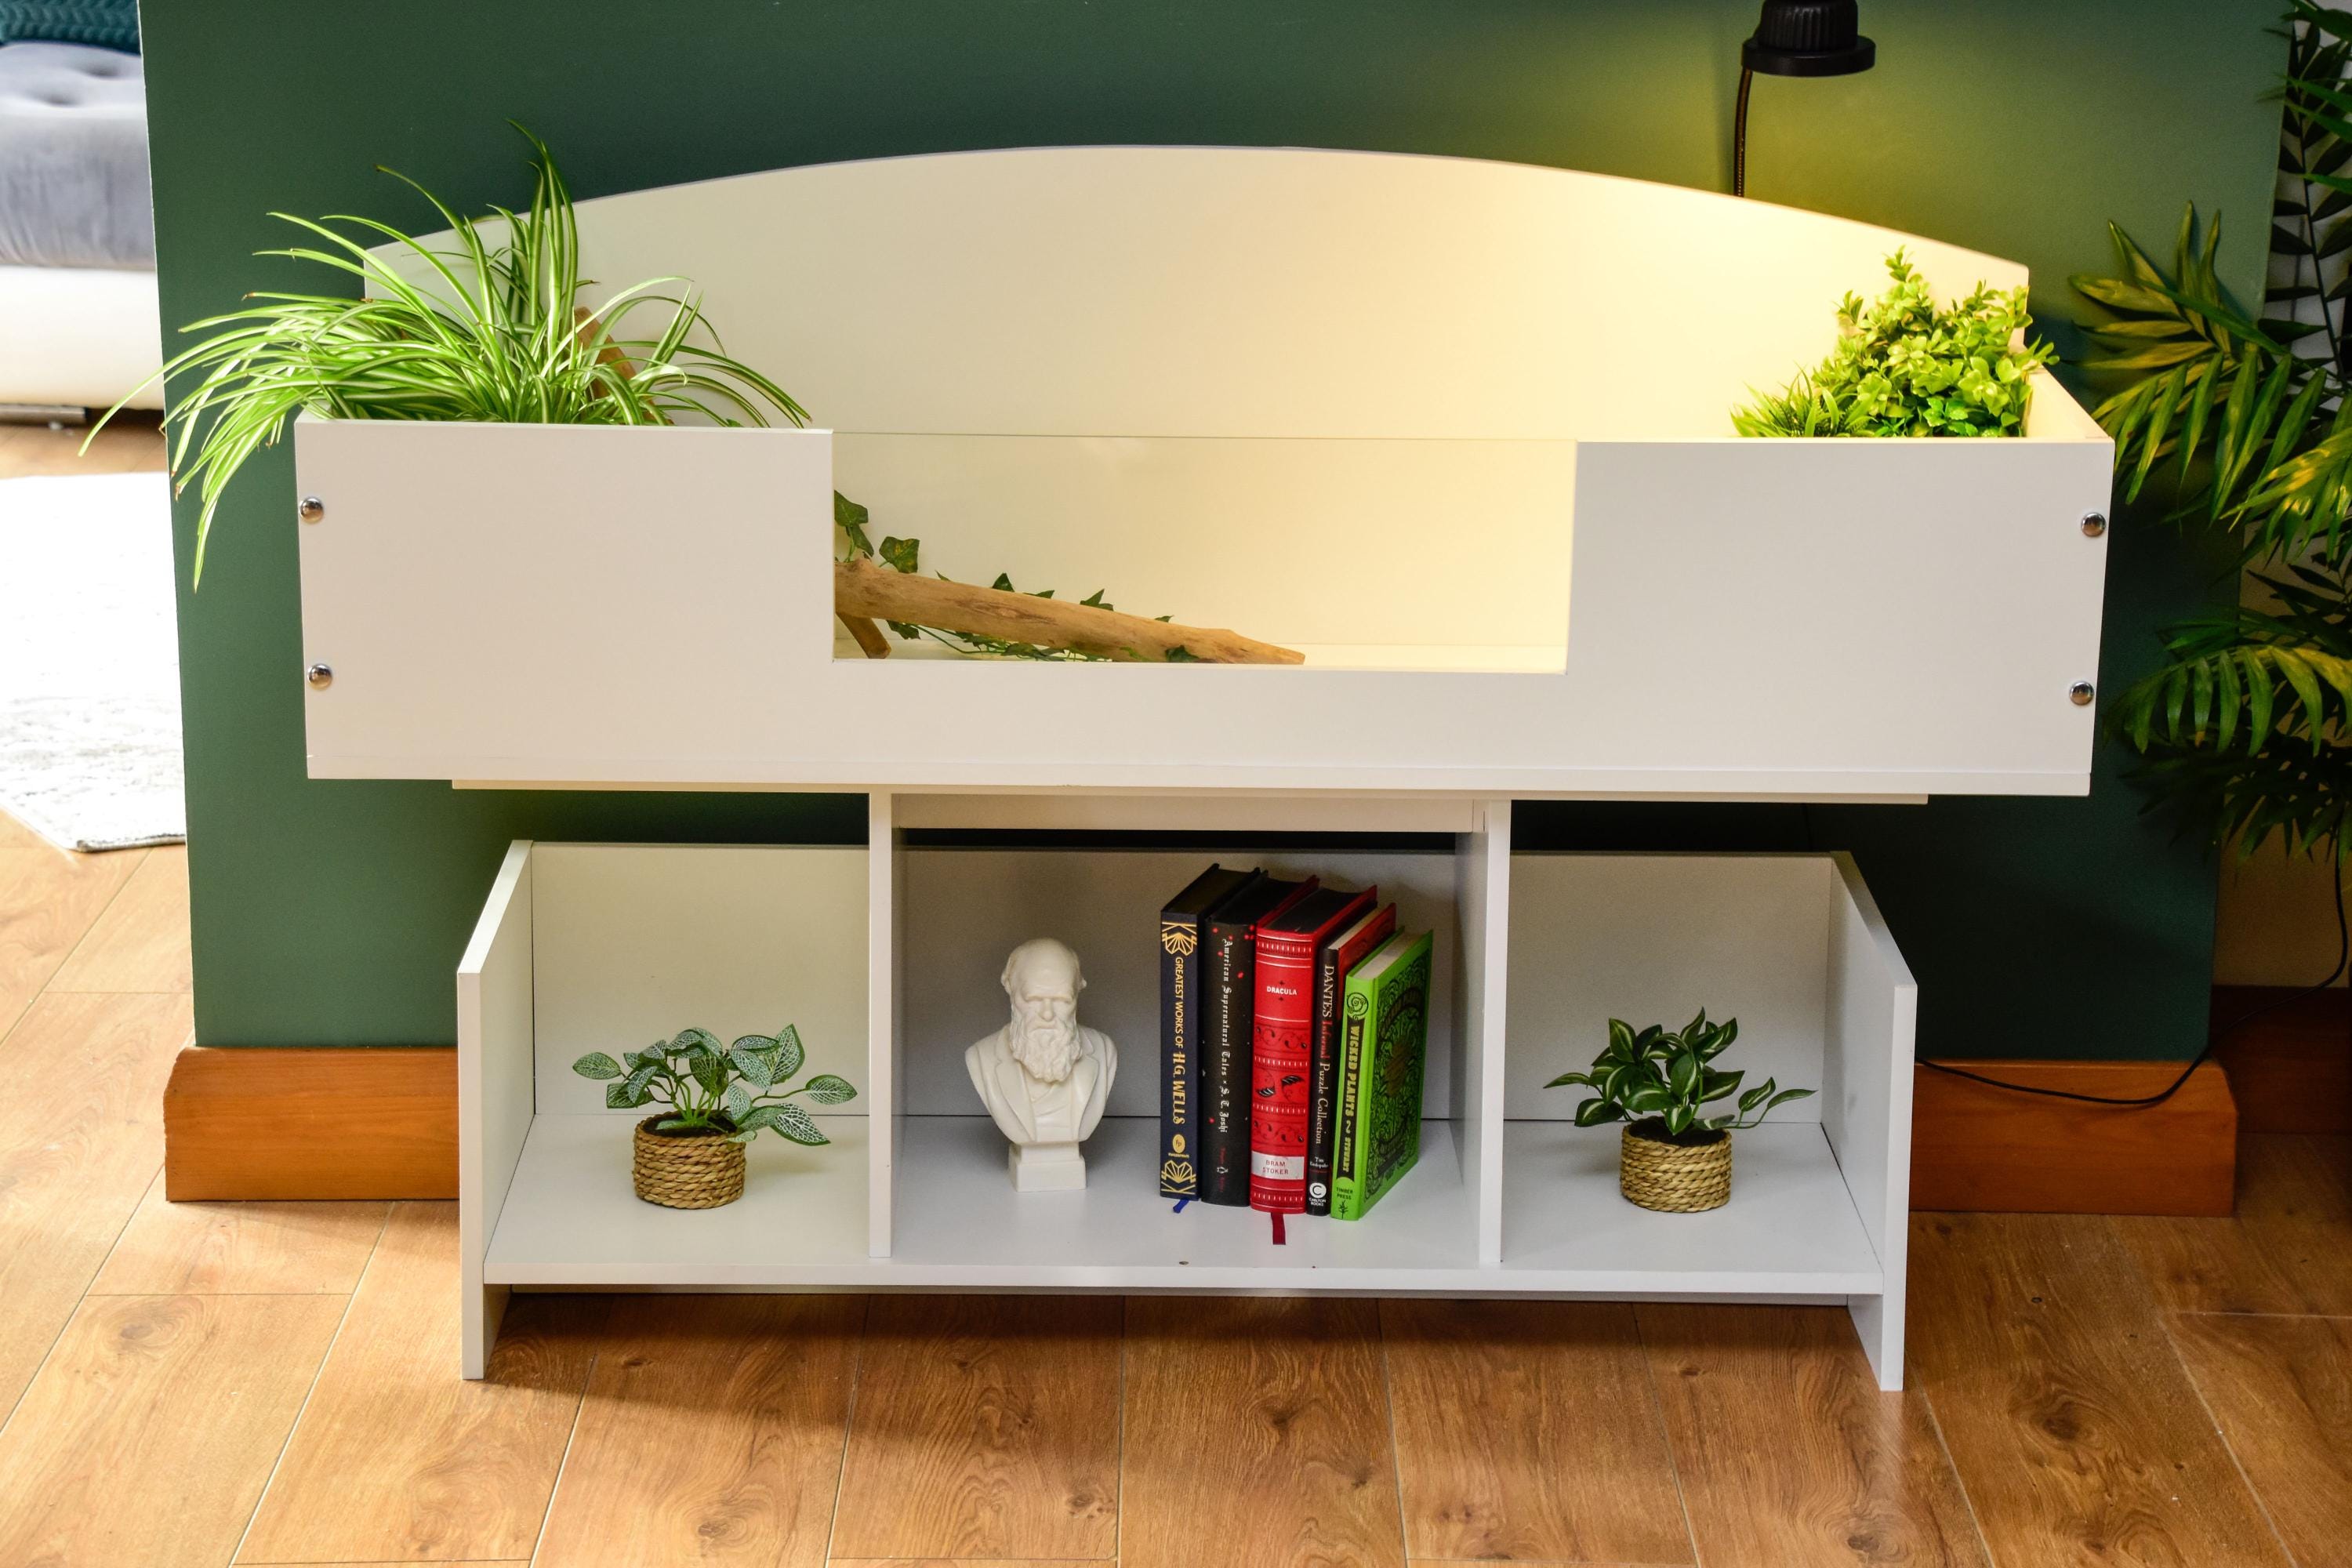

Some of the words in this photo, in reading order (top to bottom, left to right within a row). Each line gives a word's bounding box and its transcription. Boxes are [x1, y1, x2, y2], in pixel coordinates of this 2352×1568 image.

[1174, 956, 1184, 1000] GREATEST
[1222, 939, 1233, 982] American
[1266, 985, 1298, 996] DRACULA
[1174, 1002, 1184, 1035] WORKS
[1221, 985, 1232, 1047] Supernatural
[1174, 1036, 1184, 1049] OF
[1348, 1025, 1360, 1069] WICKED
[1221, 1051, 1231, 1076] Tales
[1318, 1062, 1330, 1094] Puzzle
[1173, 1080, 1185, 1124] WELLS
[1345, 1073, 1359, 1117] PLANTS
[1218, 1111, 1229, 1133] Joshi
[1316, 1098, 1328, 1145] Collection
[1342, 1137, 1352, 1172] STEWART
